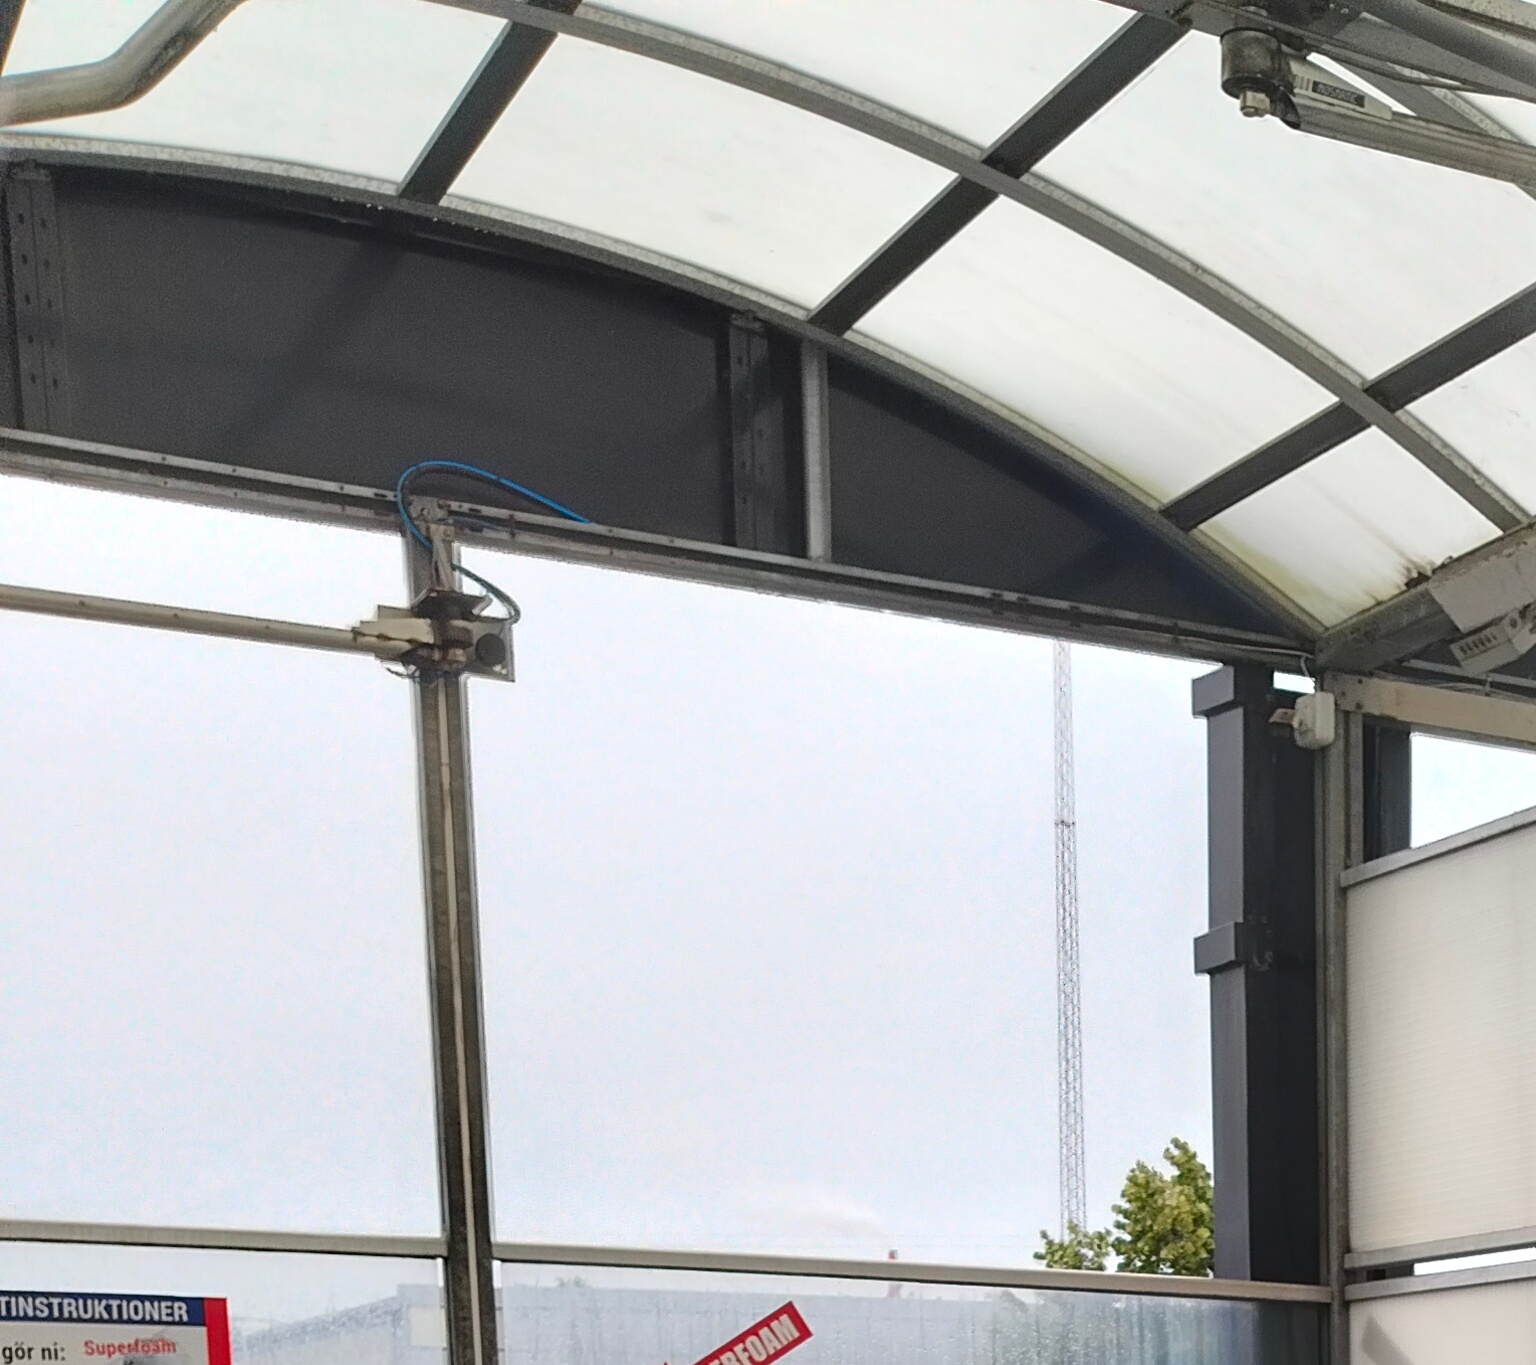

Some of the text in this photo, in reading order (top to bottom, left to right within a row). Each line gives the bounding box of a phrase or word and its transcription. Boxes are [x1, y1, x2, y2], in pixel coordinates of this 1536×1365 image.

[2, 1342, 66, 1365] gör ni:
[84, 1338, 176, 1359] Superfoam
